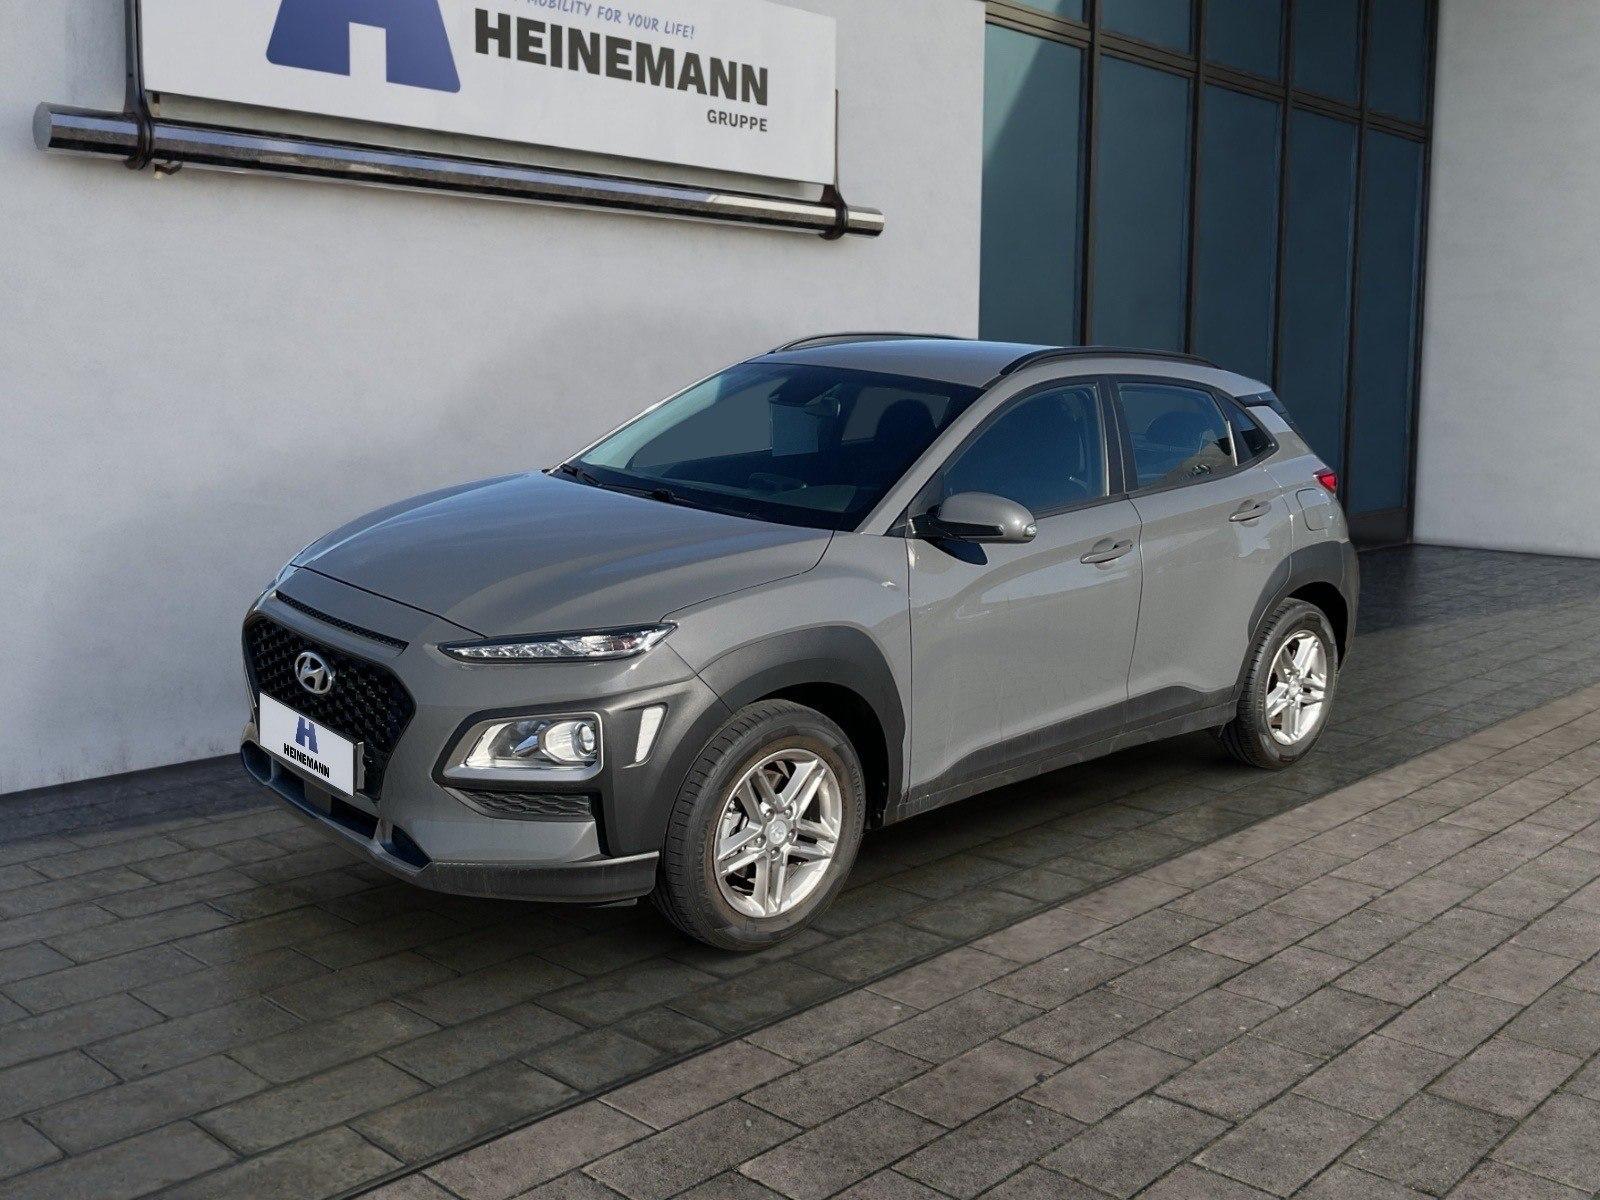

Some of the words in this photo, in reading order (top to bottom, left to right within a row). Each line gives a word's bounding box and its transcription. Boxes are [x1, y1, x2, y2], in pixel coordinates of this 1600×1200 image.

[597, 6, 621, 24] FOR
[627, 13, 659, 32] YOUR
[664, 21, 695, 40] LIFE!
[475, 8, 768, 106] HEINEMANN
[707, 109, 768, 132] GRUPPE
[283, 742, 330, 778] HEINEMANN
